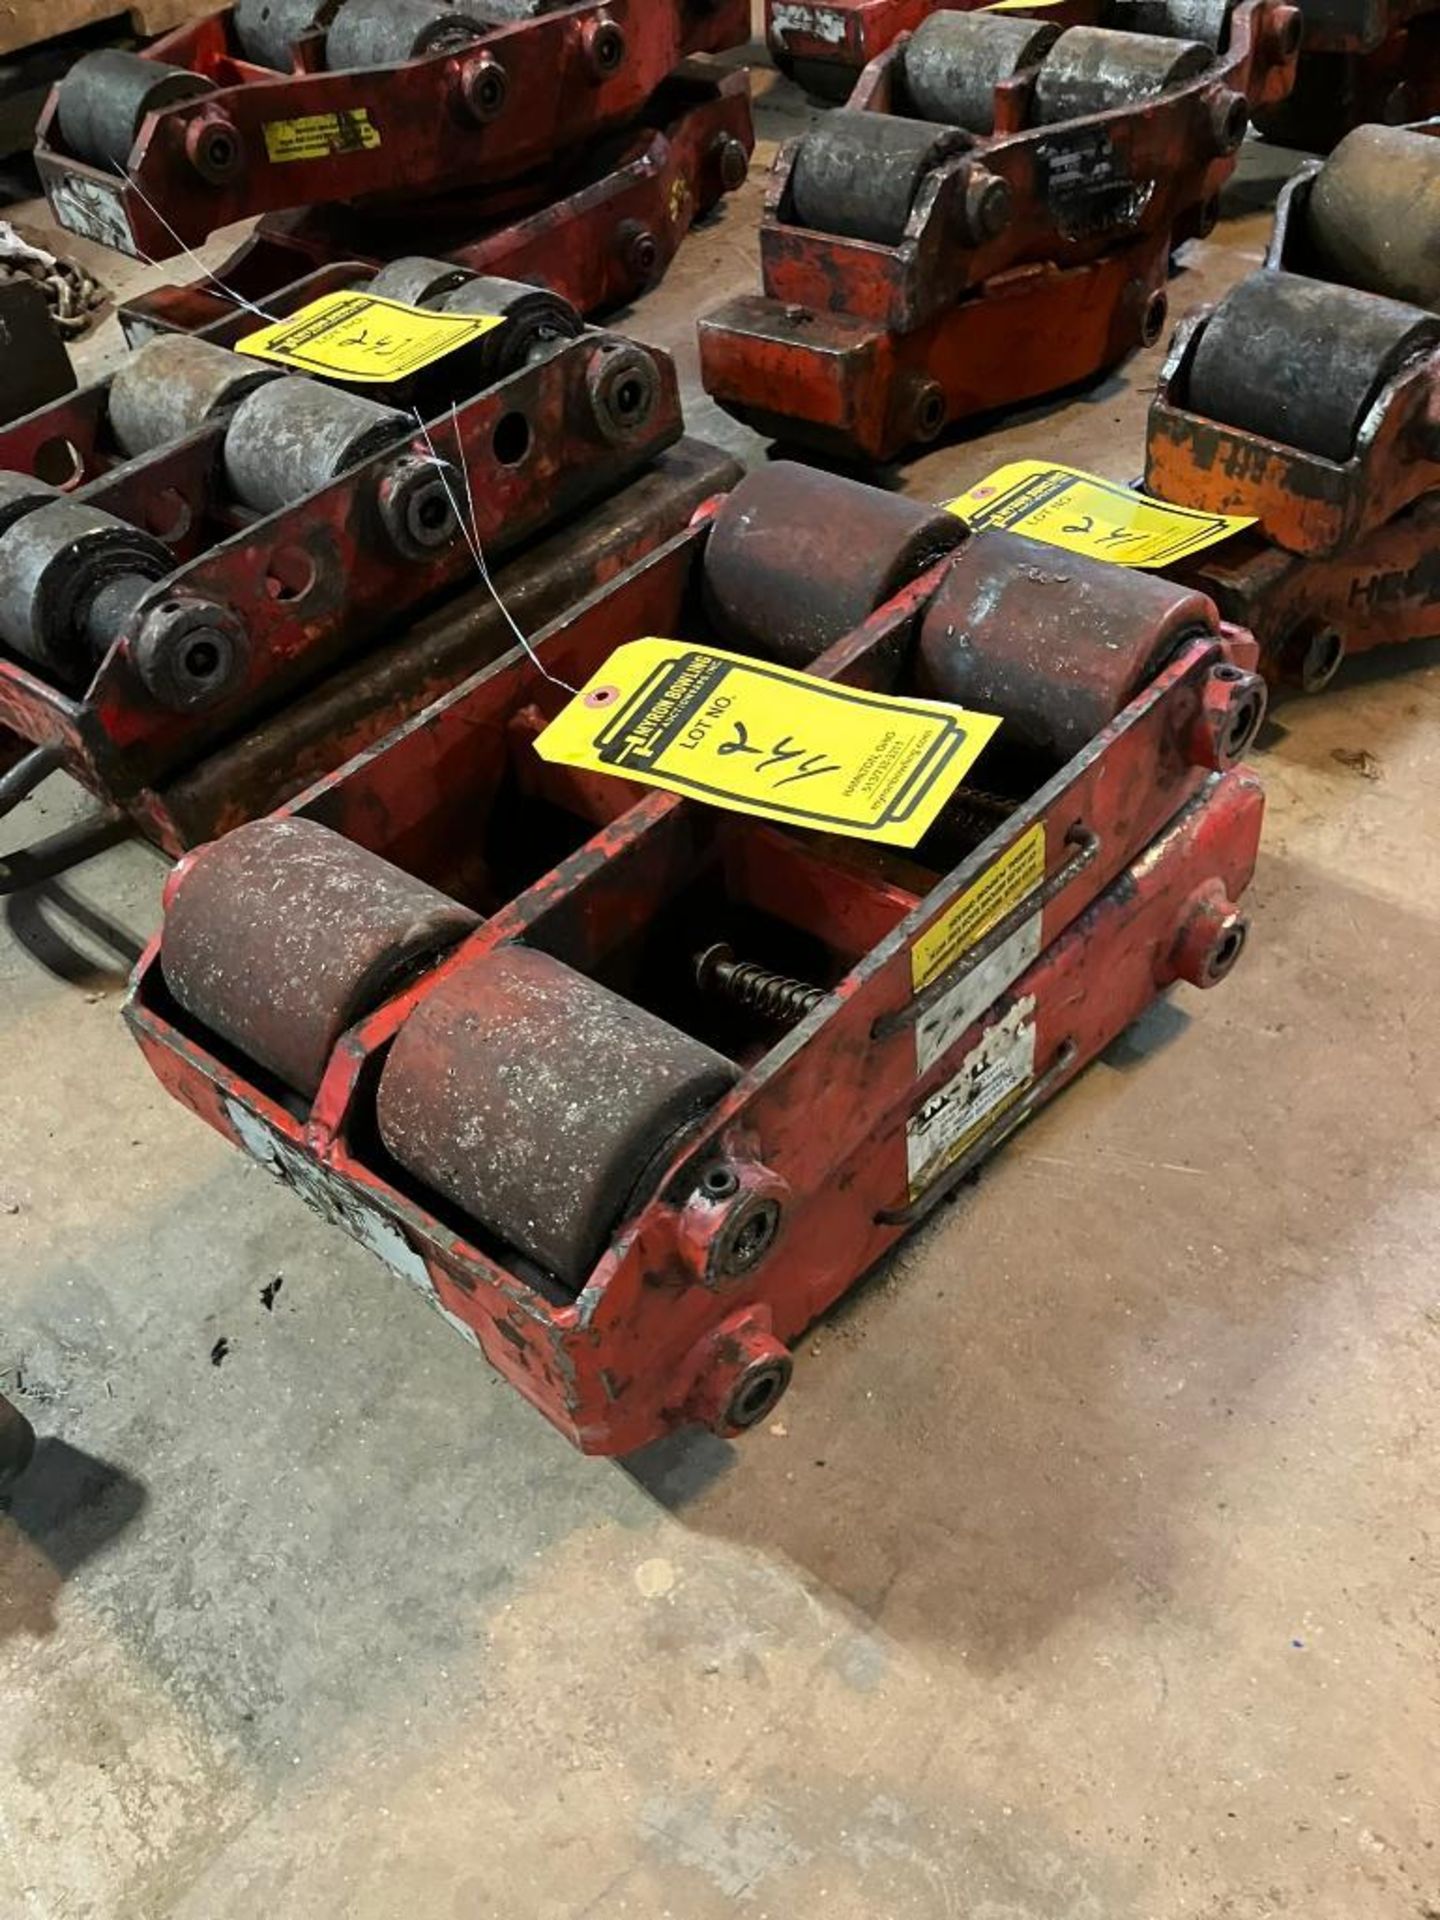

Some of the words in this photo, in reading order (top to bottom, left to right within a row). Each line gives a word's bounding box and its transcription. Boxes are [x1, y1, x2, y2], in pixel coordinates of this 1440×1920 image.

[633, 699, 671, 737] MYRON
[664, 655, 713, 700] BOWLING
[679, 719, 712, 750] LOT
[705, 695, 737, 719] NO.
